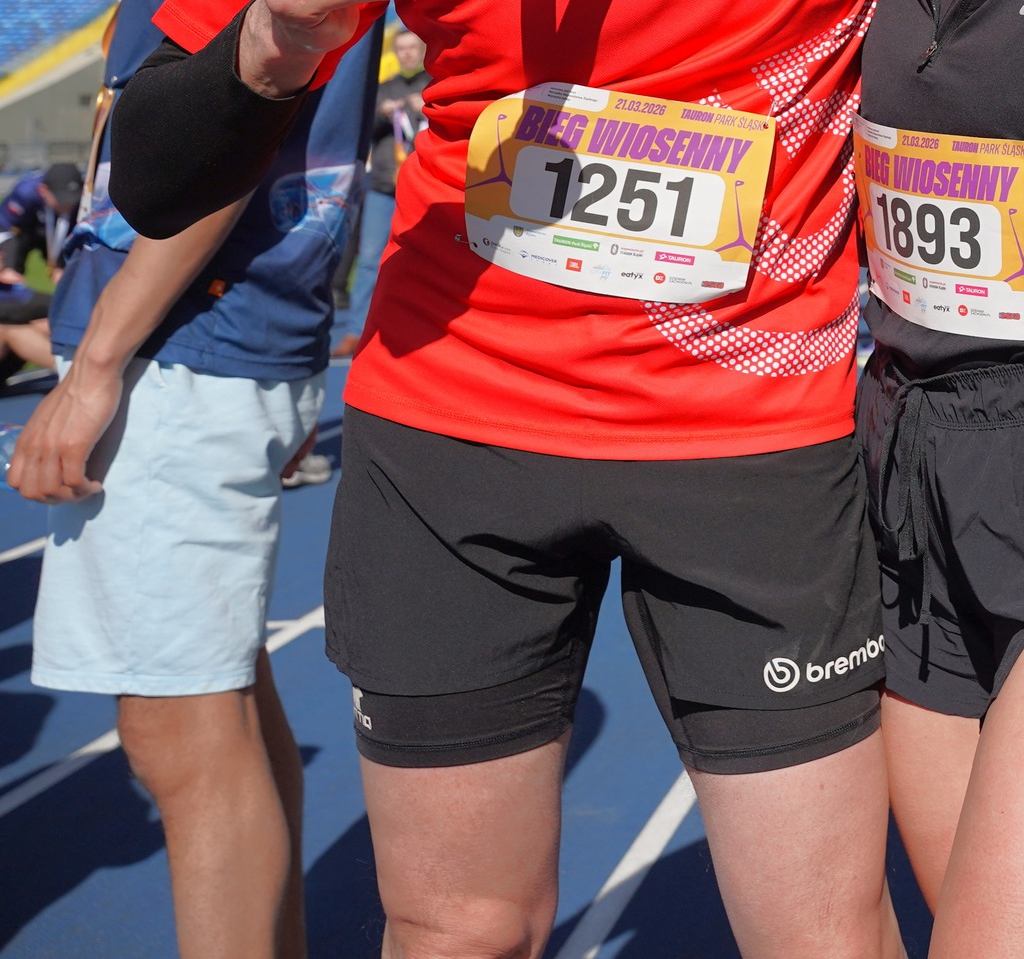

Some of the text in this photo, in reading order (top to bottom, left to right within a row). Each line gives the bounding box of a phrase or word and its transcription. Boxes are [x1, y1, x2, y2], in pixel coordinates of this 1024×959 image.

[615, 98, 667, 116] 21.03.2026
[681, 108, 714, 124] TAURON
[714, 111, 738, 127] PARK
[514, 105, 754, 174] BIEG WIOSENNY
[902, 134, 940, 149] 21.03.2026
[952, 140, 979, 153] TAURON
[979, 142, 1000, 154] PARK
[864, 144, 1019, 203] BIEG WIOSENNY
[545, 158, 695, 238] 1251
[876, 193, 981, 270] 1893
[621, 271, 644, 280] eatyx
[668, 255, 692, 263] TAURON
[965, 287, 986, 295] TAURON
[806, 634, 885, 683] brembo
